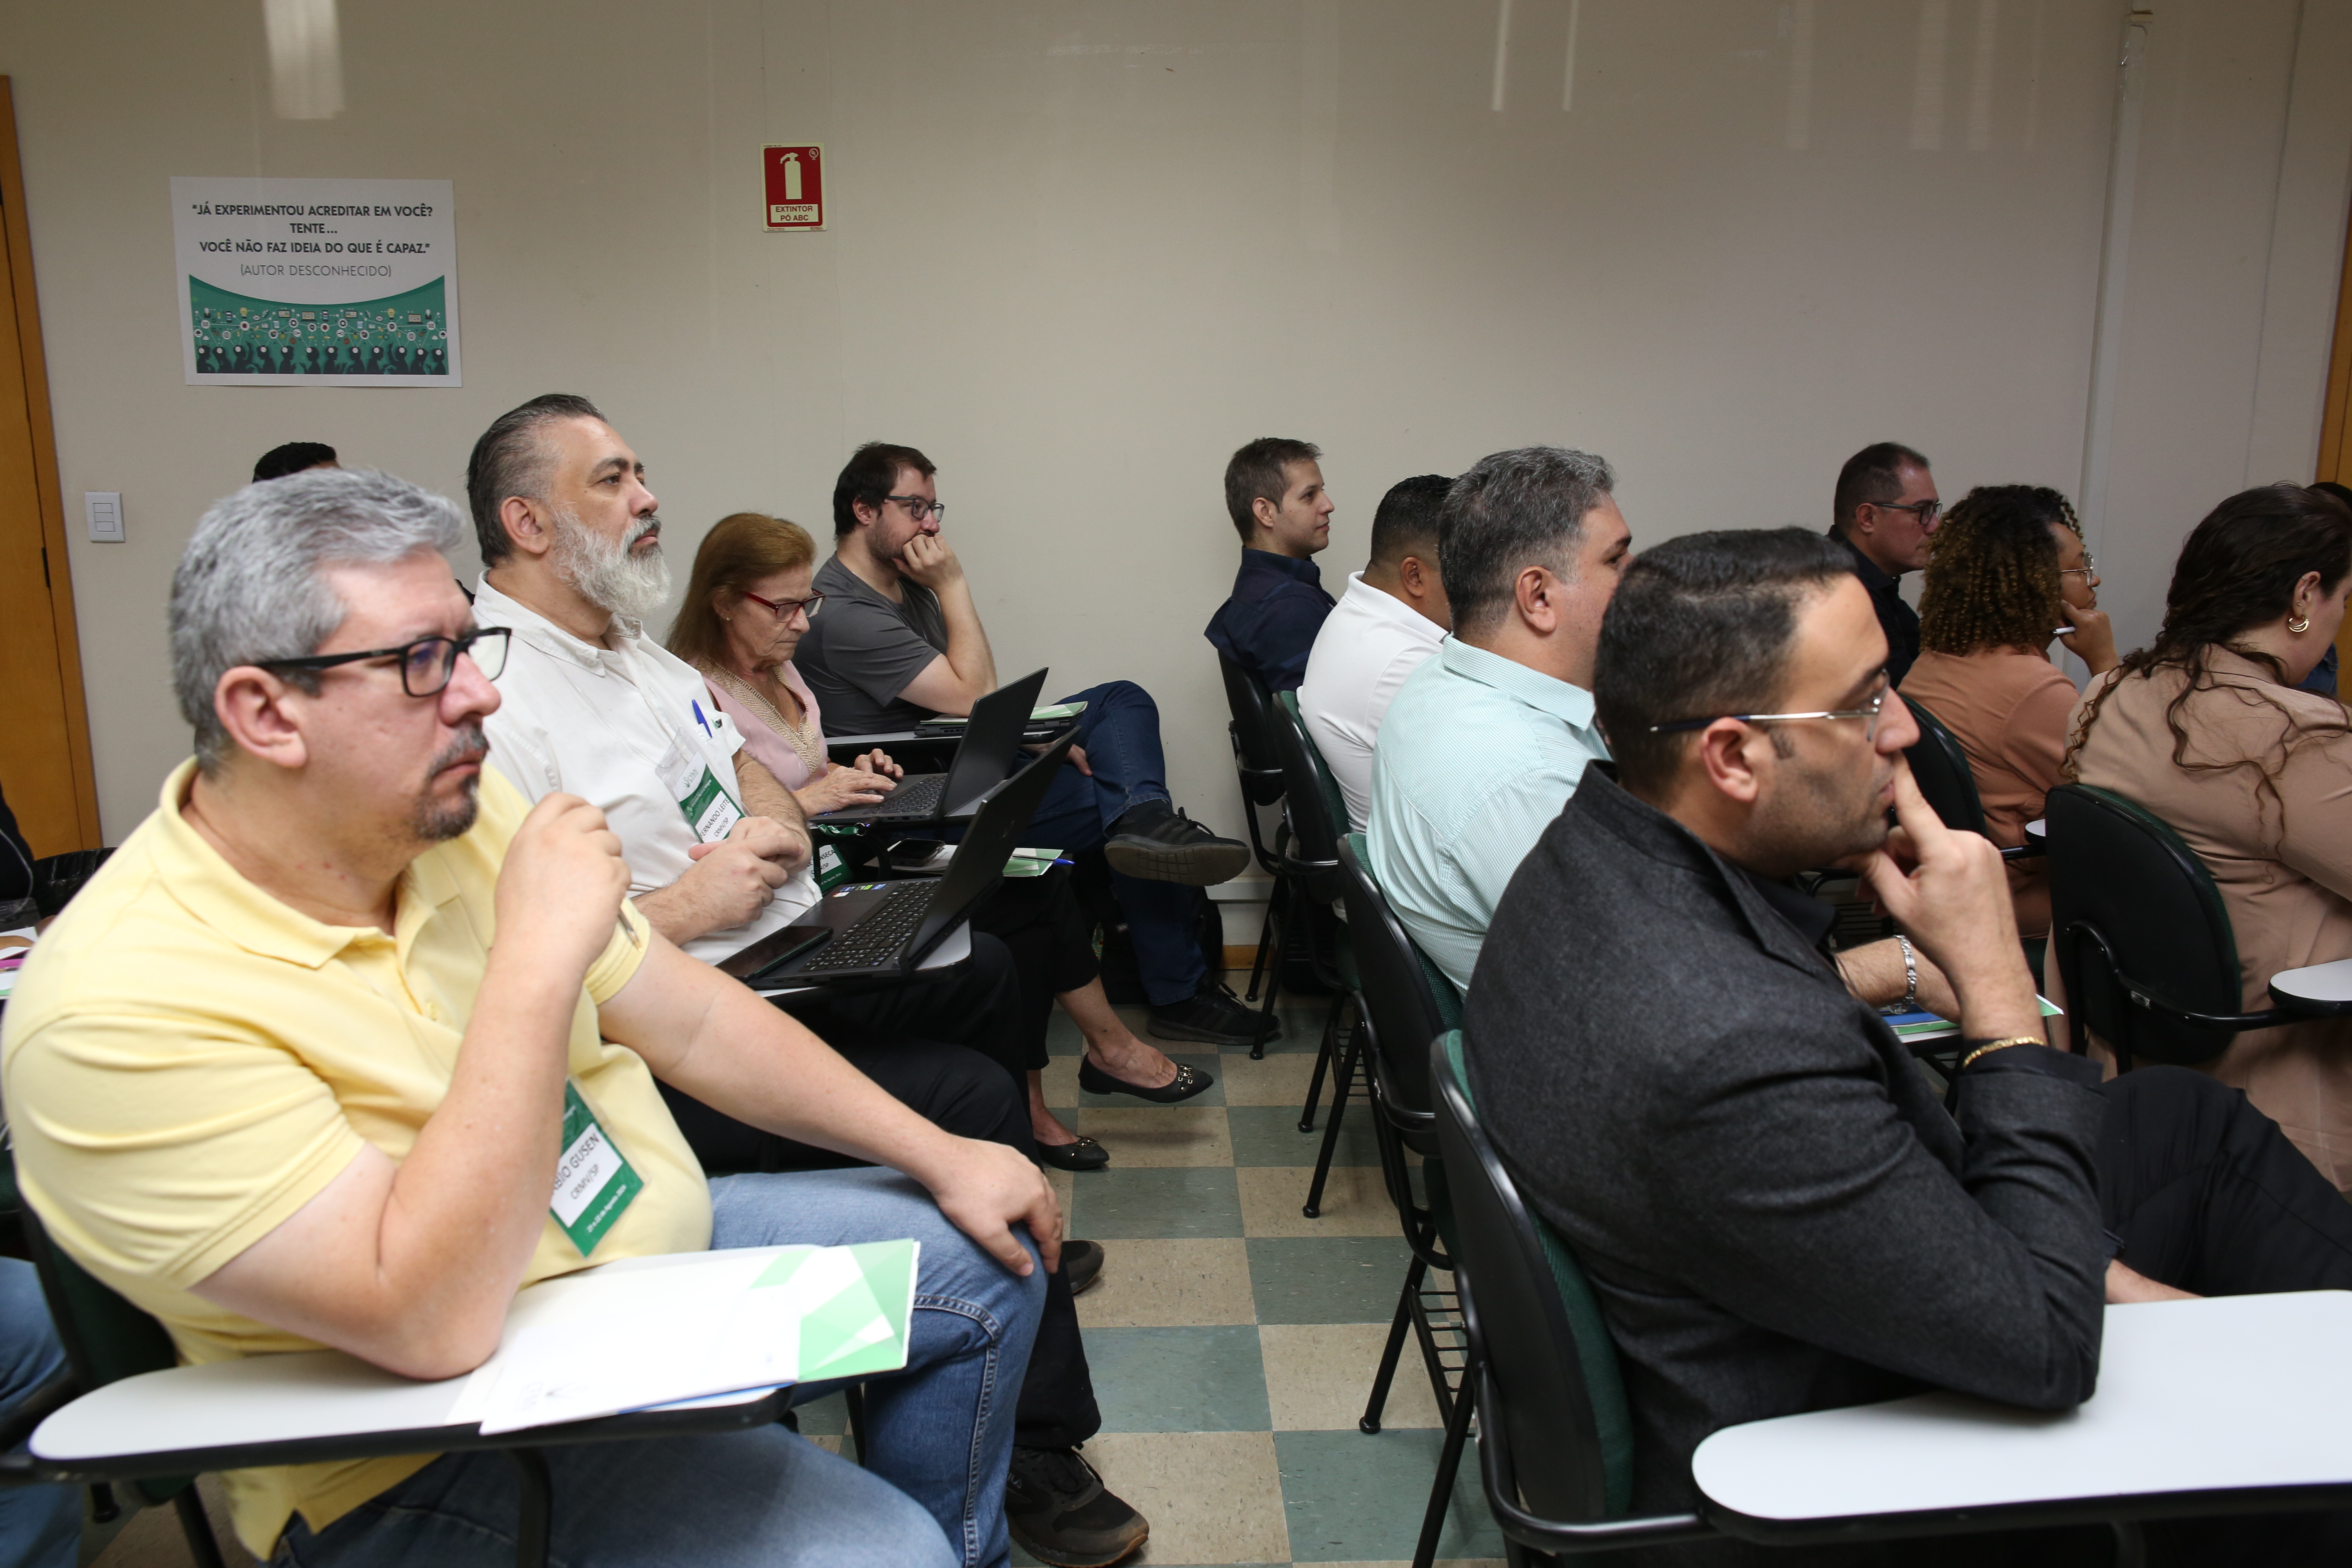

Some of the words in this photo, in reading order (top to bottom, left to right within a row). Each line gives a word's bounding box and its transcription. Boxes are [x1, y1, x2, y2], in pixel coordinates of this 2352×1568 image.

[215, 205, 304, 216] EXPERIMENTOU
[308, 205, 370, 216] ACREDITAR
[374, 206, 392, 216] EM
[394, 203, 432, 216] VOCÊ?
[199, 238, 232, 252] VOCÊ
[236, 239, 263, 252] NÃO
[267, 243, 287, 252] FAZ
[291, 243, 321, 253] IDEIA
[325, 243, 343, 253] DO
[347, 243, 372, 253] QUE
[376, 240, 382, 253] É
[241, 264, 285, 276] (AUTOR
[290, 265, 391, 277] DESCONHECIDO)
[699, 810, 720, 839] FERNANDO
[718, 797, 731, 812] LEITE
[713, 817, 729, 837] CRMV/SP
[554, 1166, 571, 1190] BIO
[570, 1132, 599, 1168] GUSEN
[570, 1165, 598, 1199] CRMV/SP
